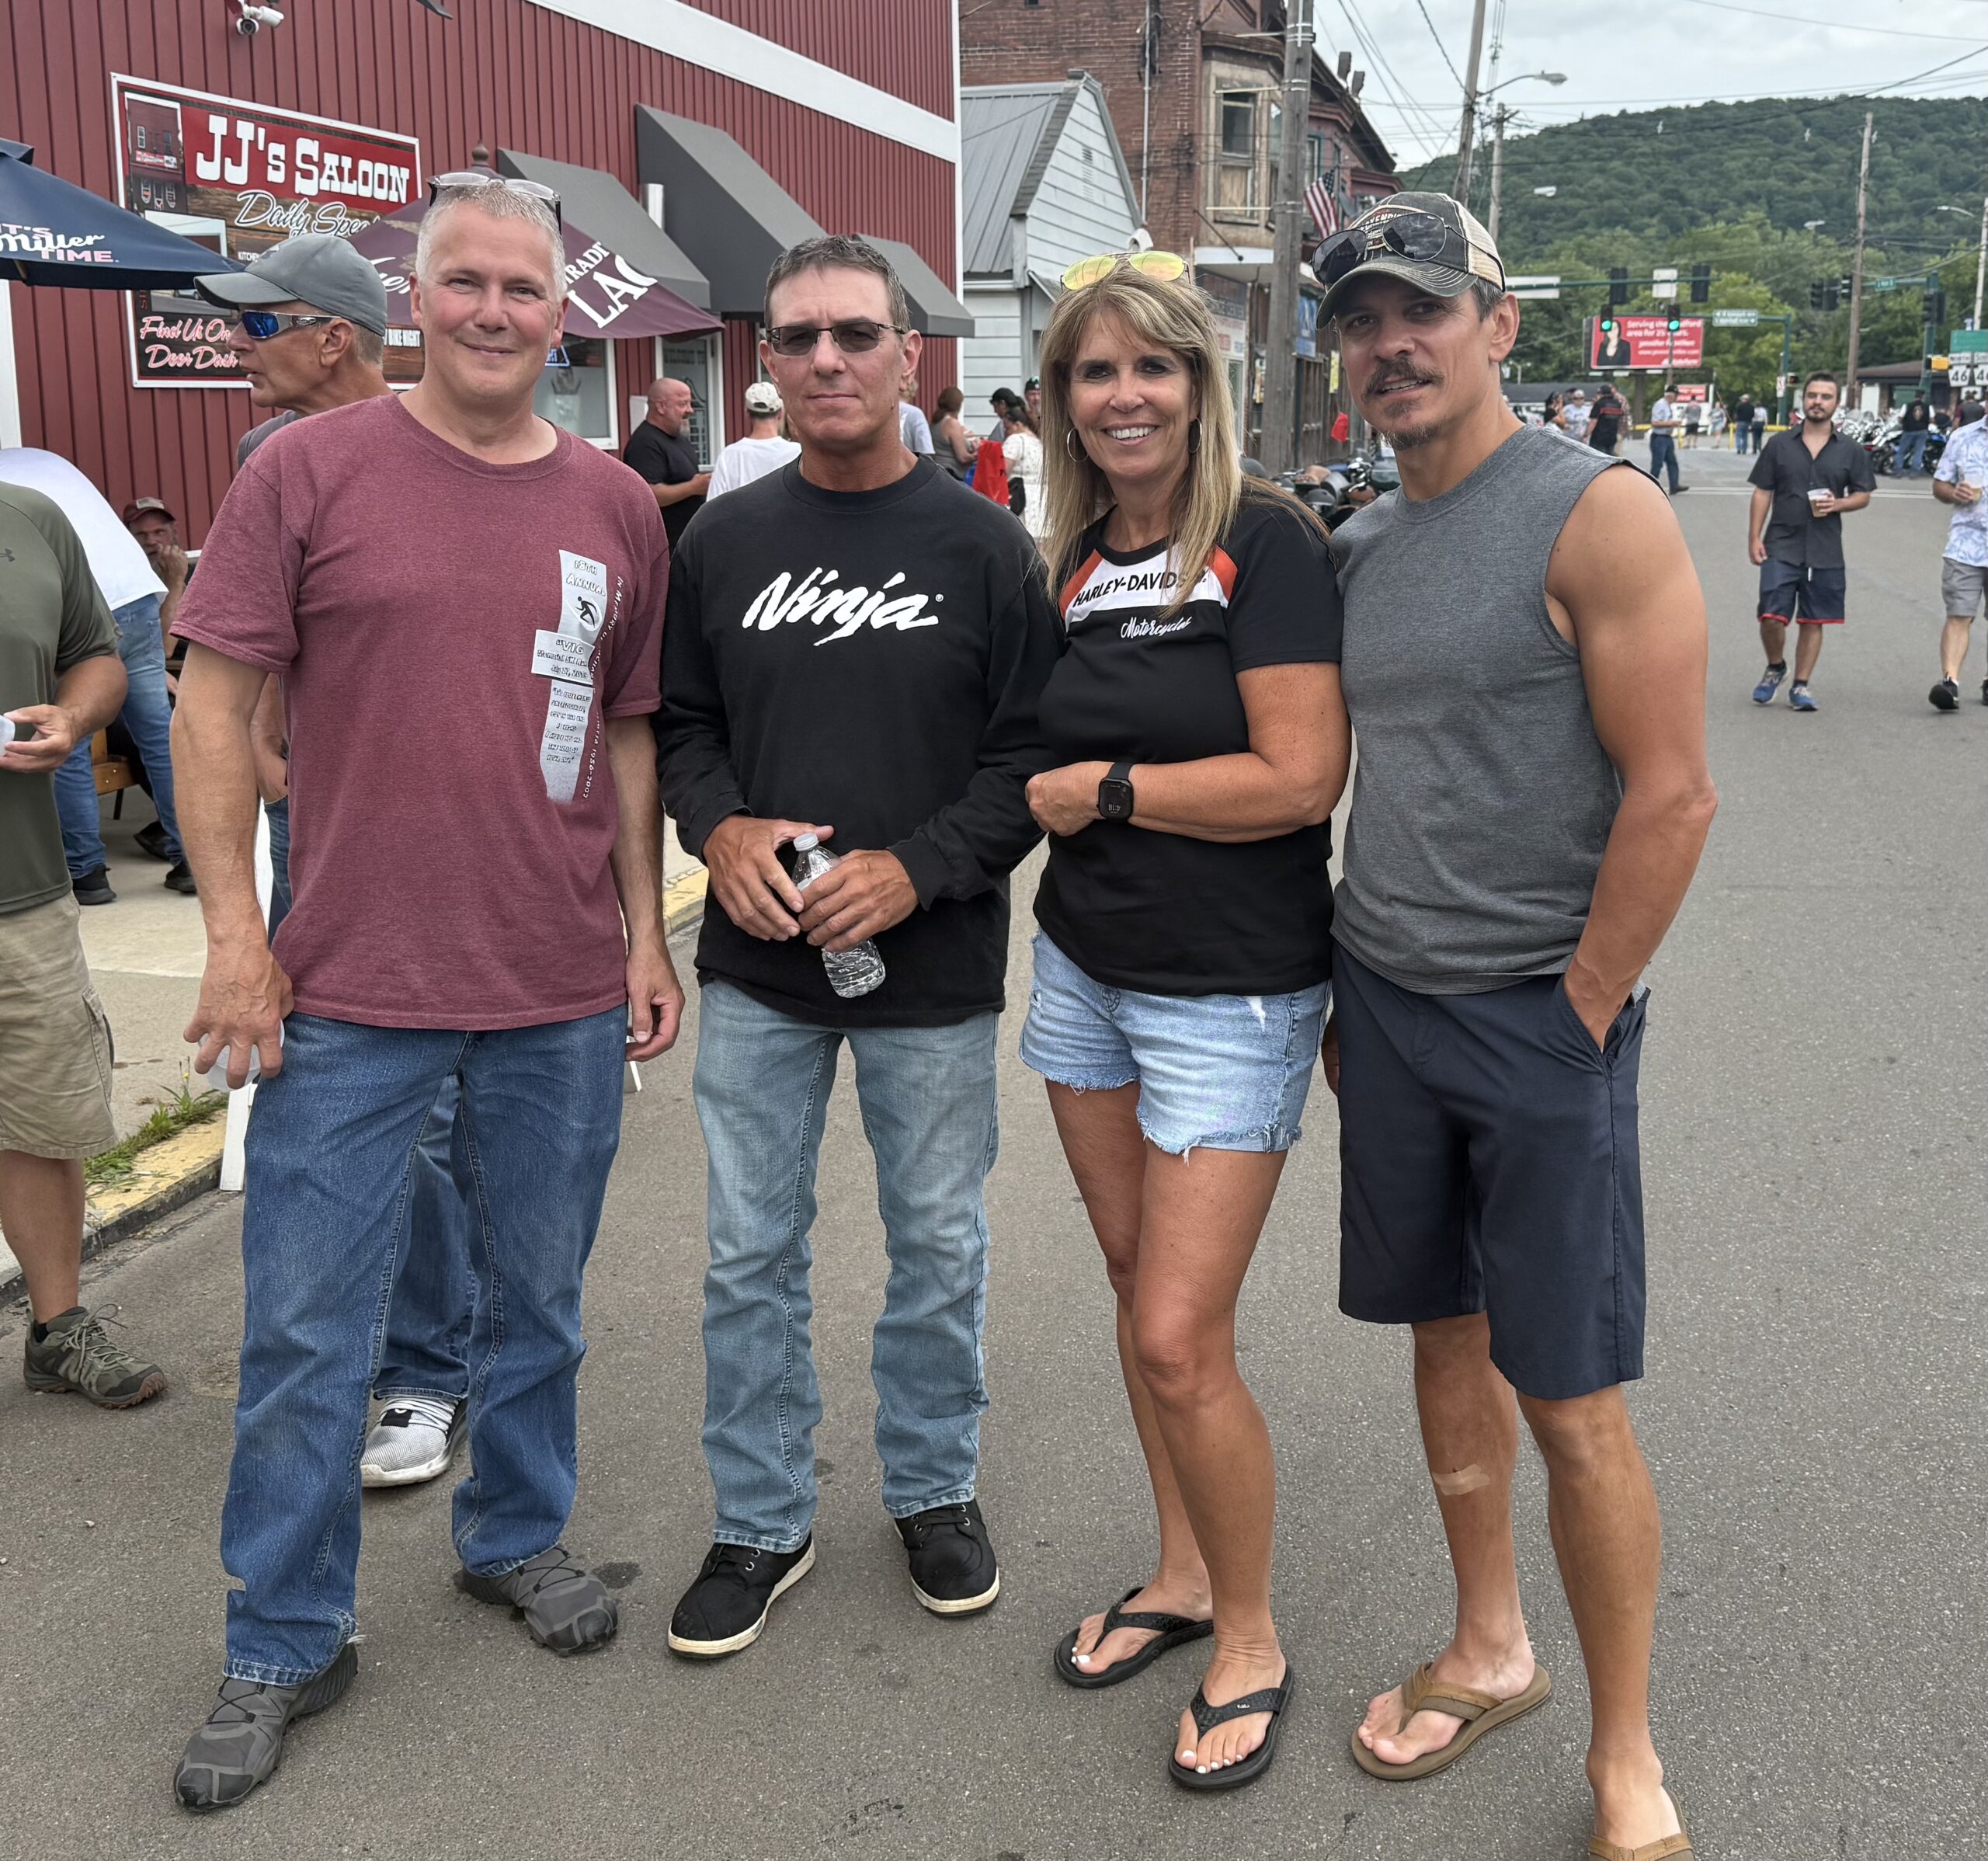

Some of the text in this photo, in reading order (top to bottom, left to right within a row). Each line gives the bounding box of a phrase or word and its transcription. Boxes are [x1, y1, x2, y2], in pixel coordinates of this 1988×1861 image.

[235, 190, 312, 238] Daily
[140, 316, 182, 339] Find
[145, 344, 193, 369] Door
[1952, 369, 1968, 382] 46
[1976, 369, 1988, 381] 4
[566, 573, 606, 597] ANNUAL
[1072, 570, 1208, 607] HARLEY-DAVID
[742, 567, 939, 646] Ninja
